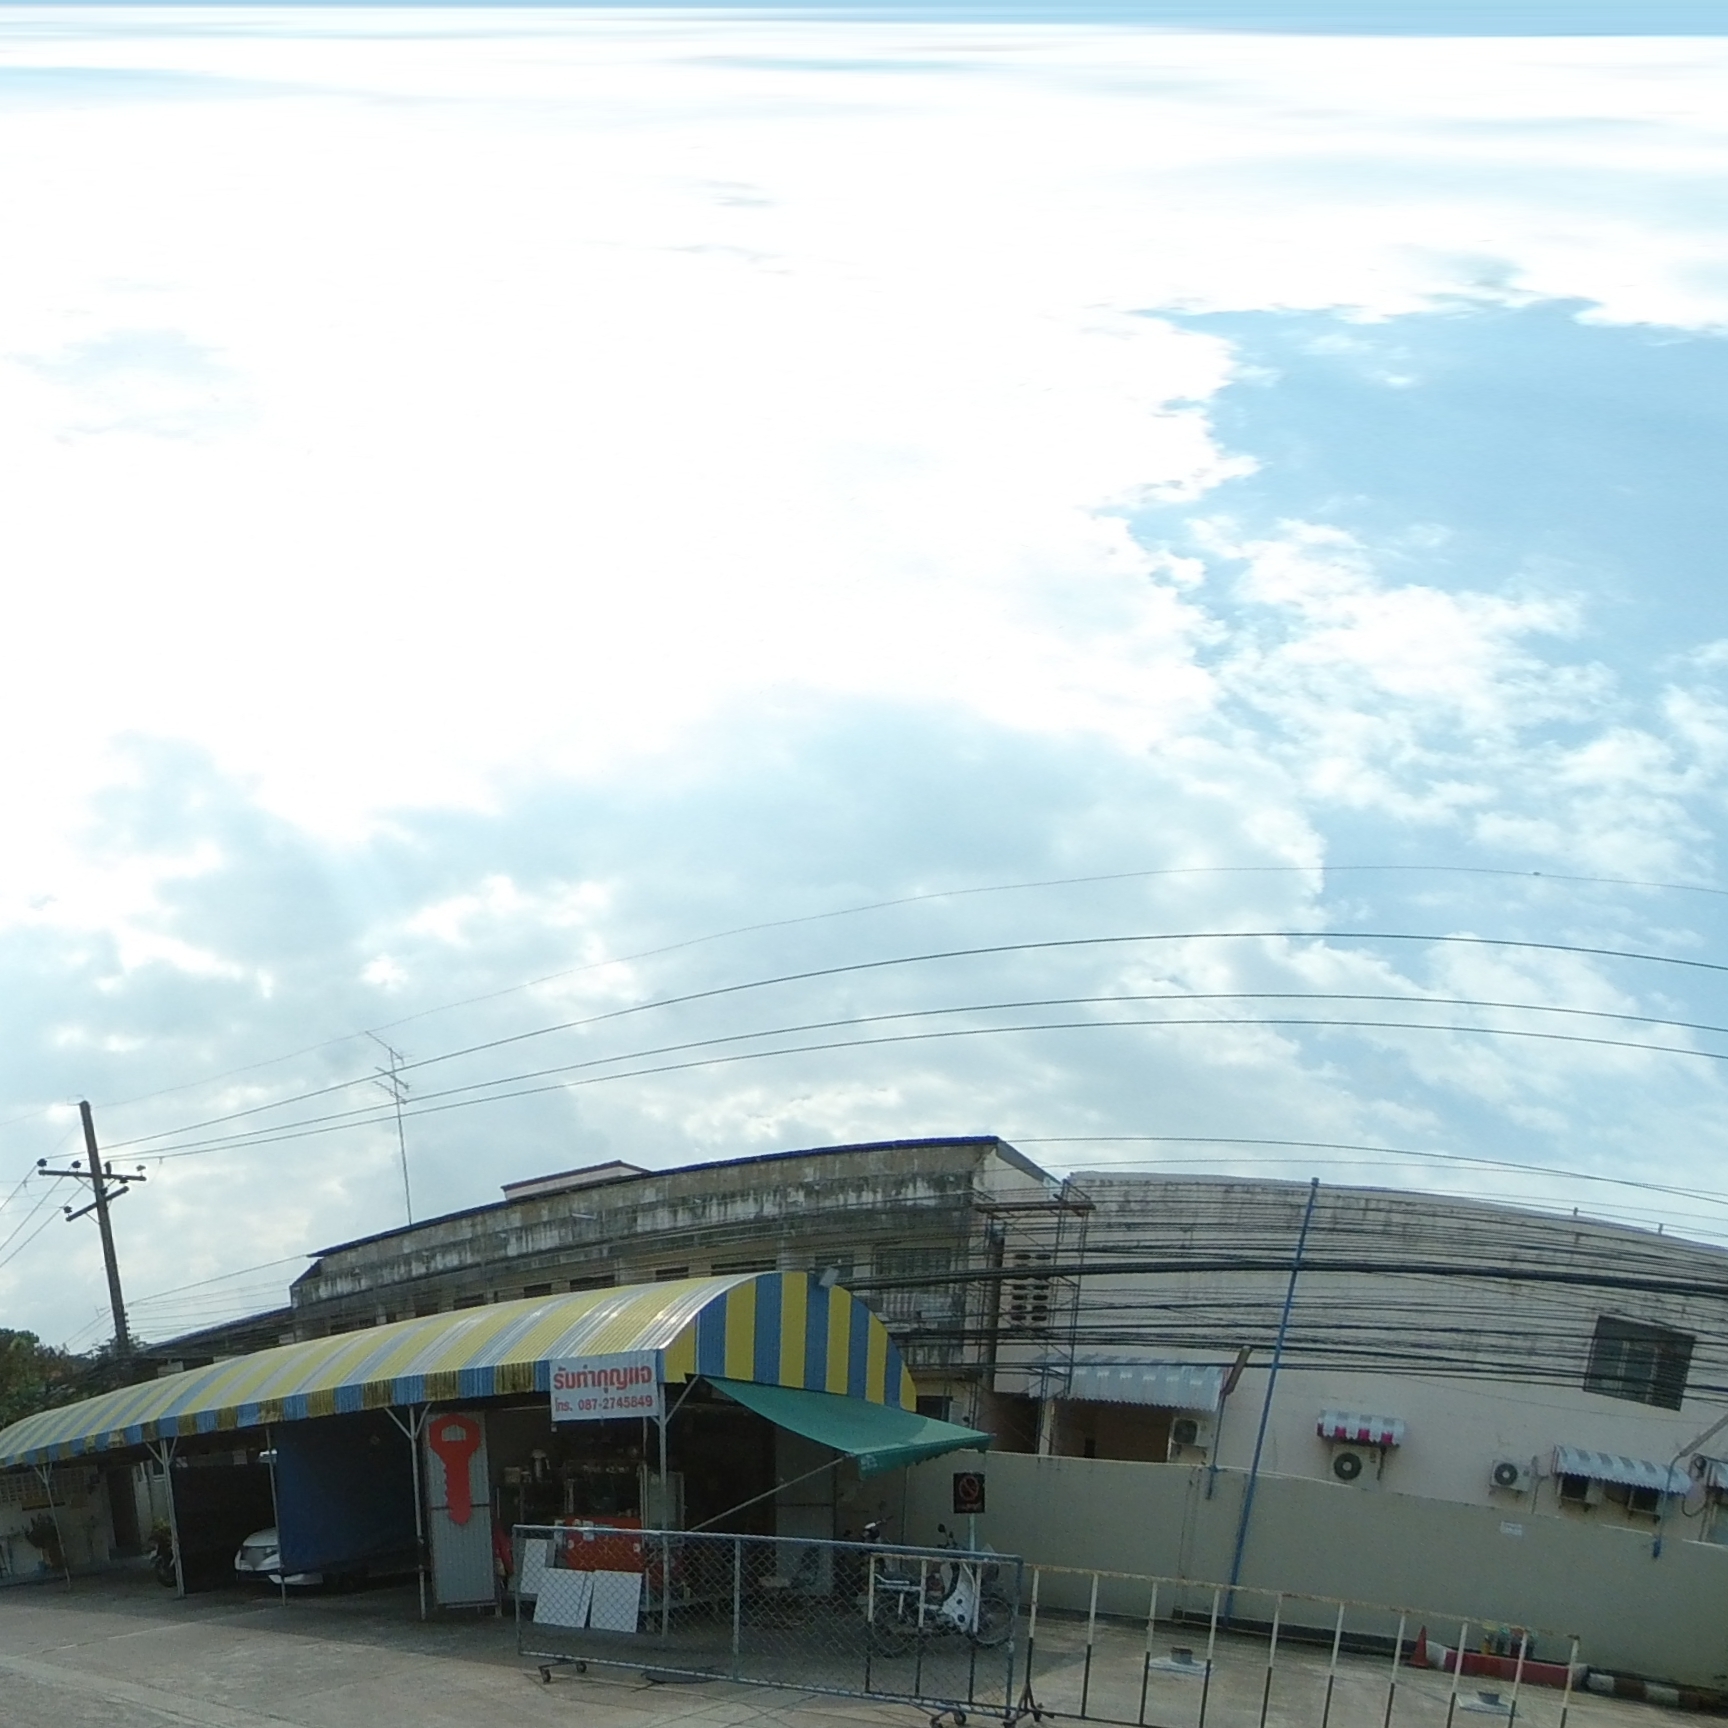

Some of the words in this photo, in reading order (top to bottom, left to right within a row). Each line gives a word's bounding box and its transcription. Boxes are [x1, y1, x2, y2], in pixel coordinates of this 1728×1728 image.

[553, 1364, 652, 1394] รับทำกุญแจ
[577, 1395, 653, 1411] 087-2745849
